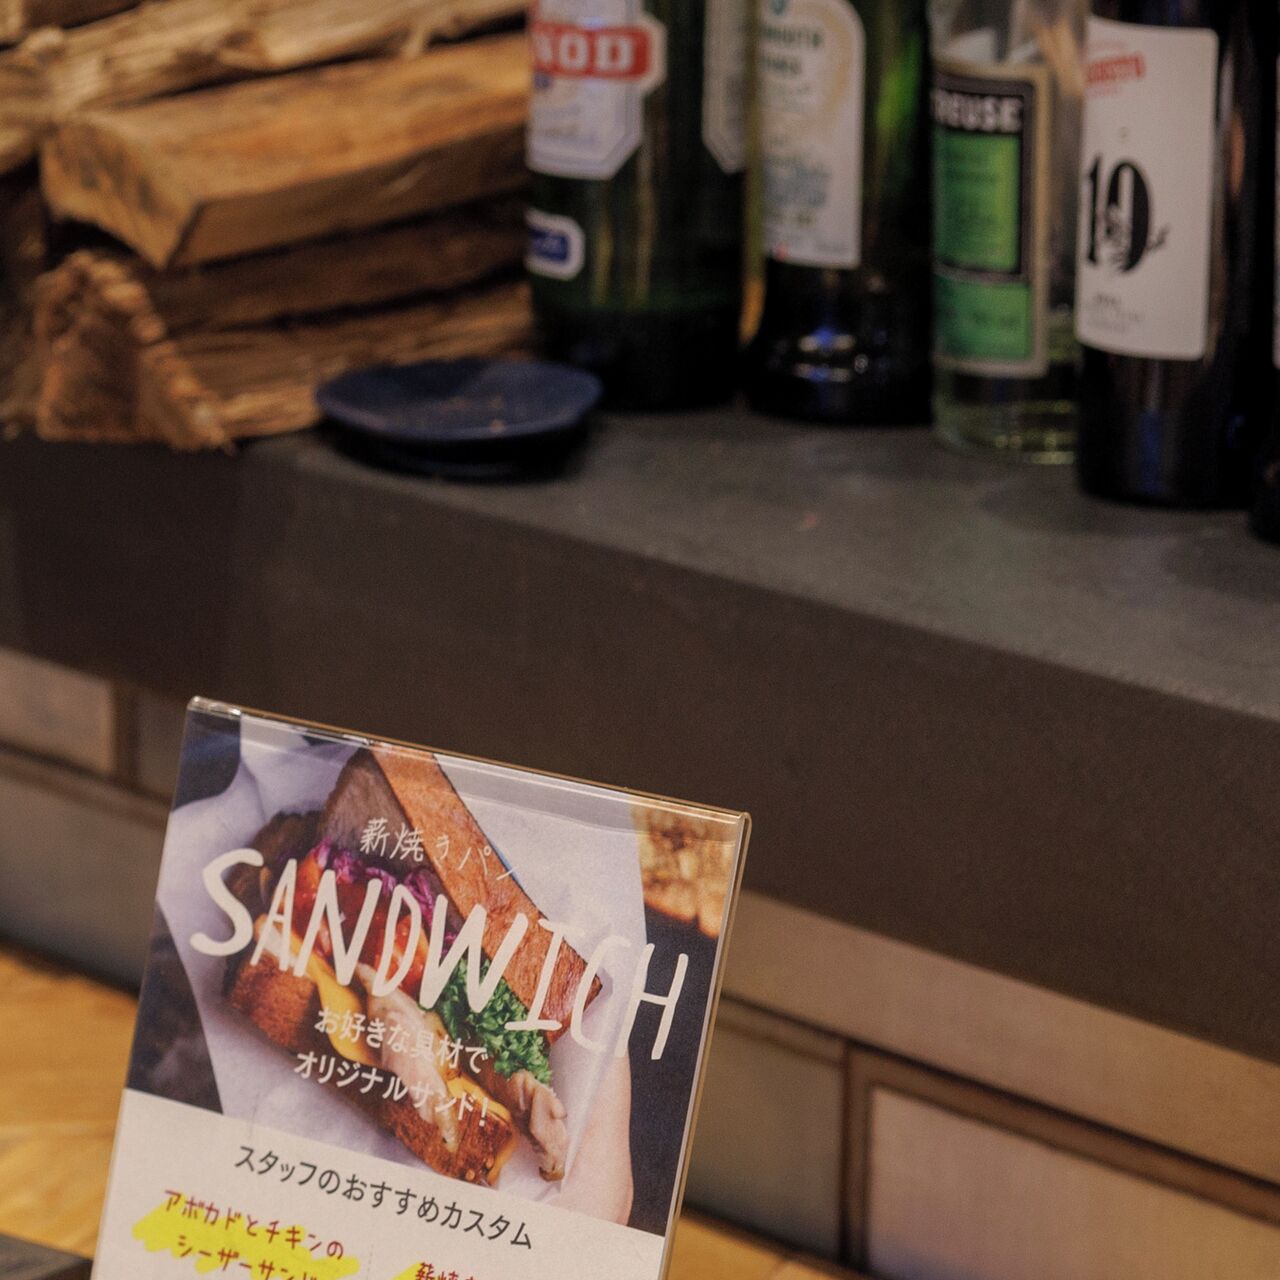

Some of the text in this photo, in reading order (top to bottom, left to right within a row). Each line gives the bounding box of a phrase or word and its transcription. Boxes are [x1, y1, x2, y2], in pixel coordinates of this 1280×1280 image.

[189, 847, 690, 1061] SANDWICH
[313, 1007, 489, 1074] お好きな具材で
[165, 1189, 344, 1260] アボカドとチキンの
[234, 1146, 533, 1250] スタッフのおすすめカスタム
